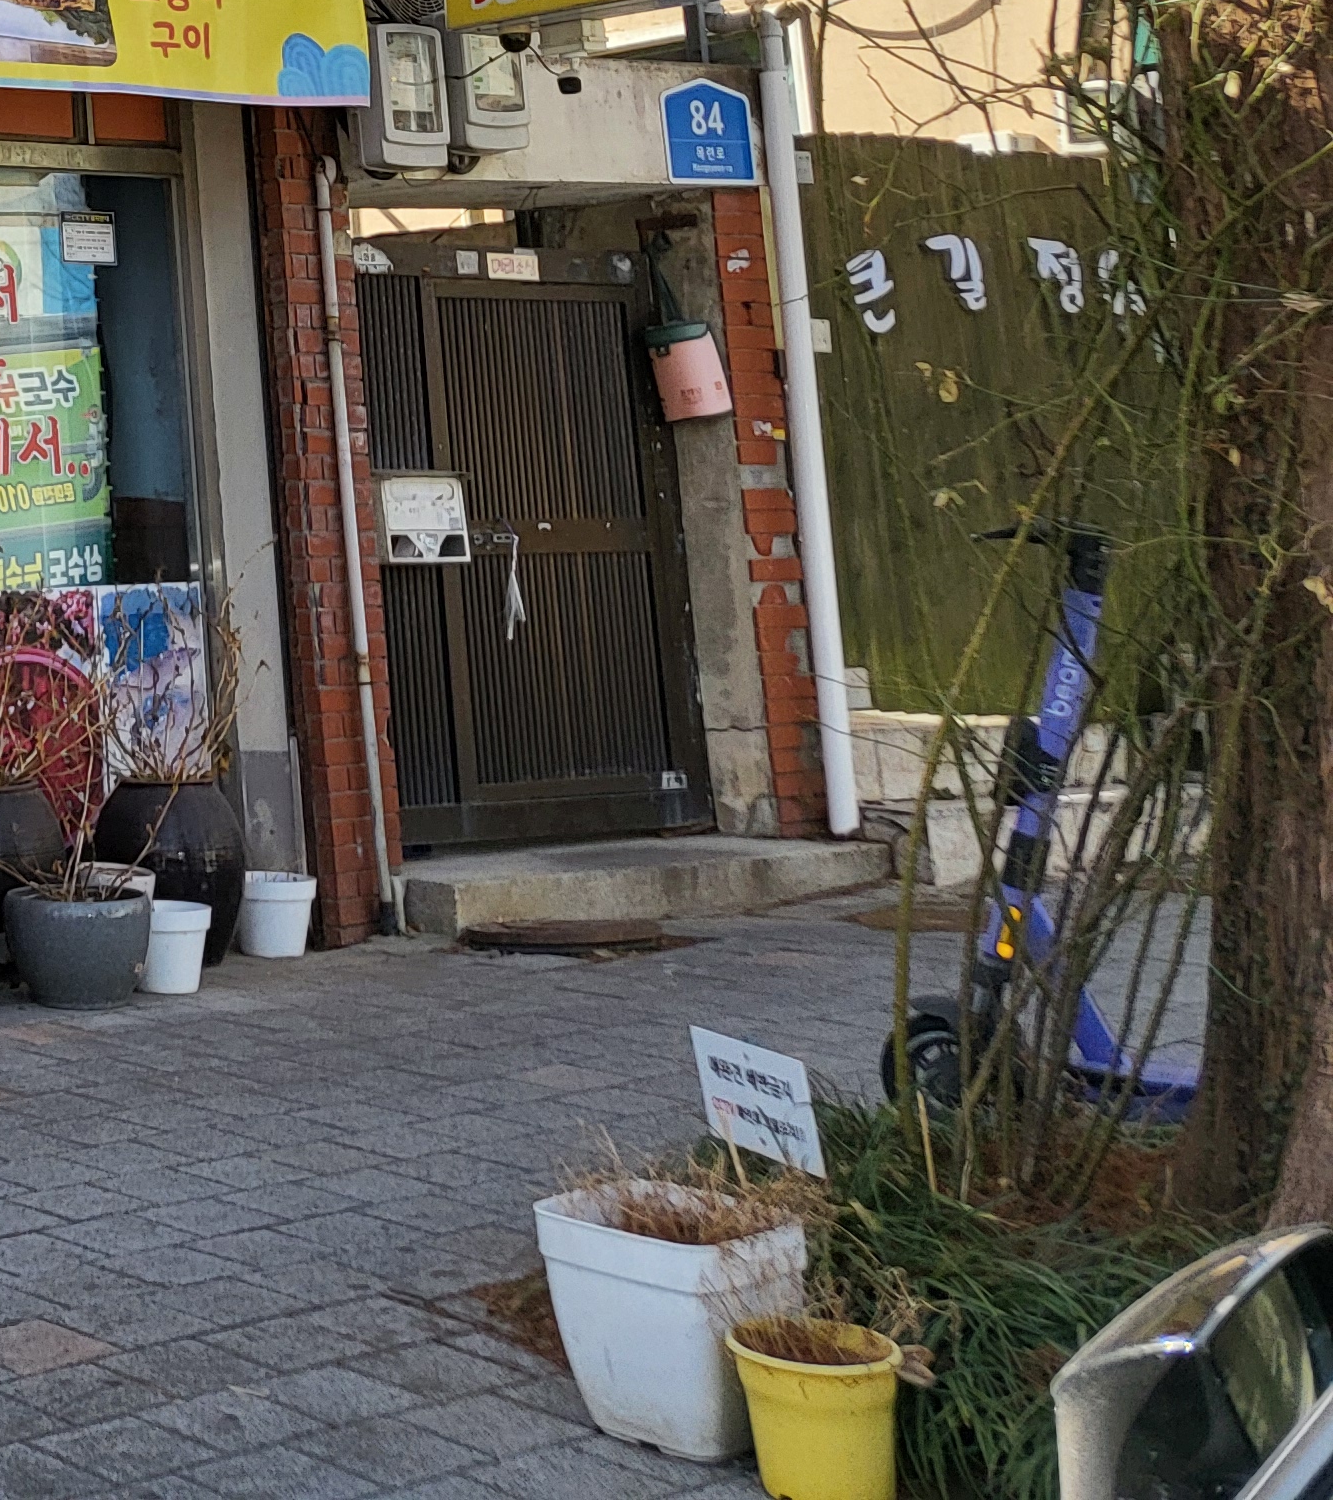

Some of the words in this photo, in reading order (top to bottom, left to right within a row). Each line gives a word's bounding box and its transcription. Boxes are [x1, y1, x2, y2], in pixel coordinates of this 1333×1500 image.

[151, 21, 212, 59] 구이
[689, 99, 726, 137] 84
[695, 145, 726, 161] 목련로
